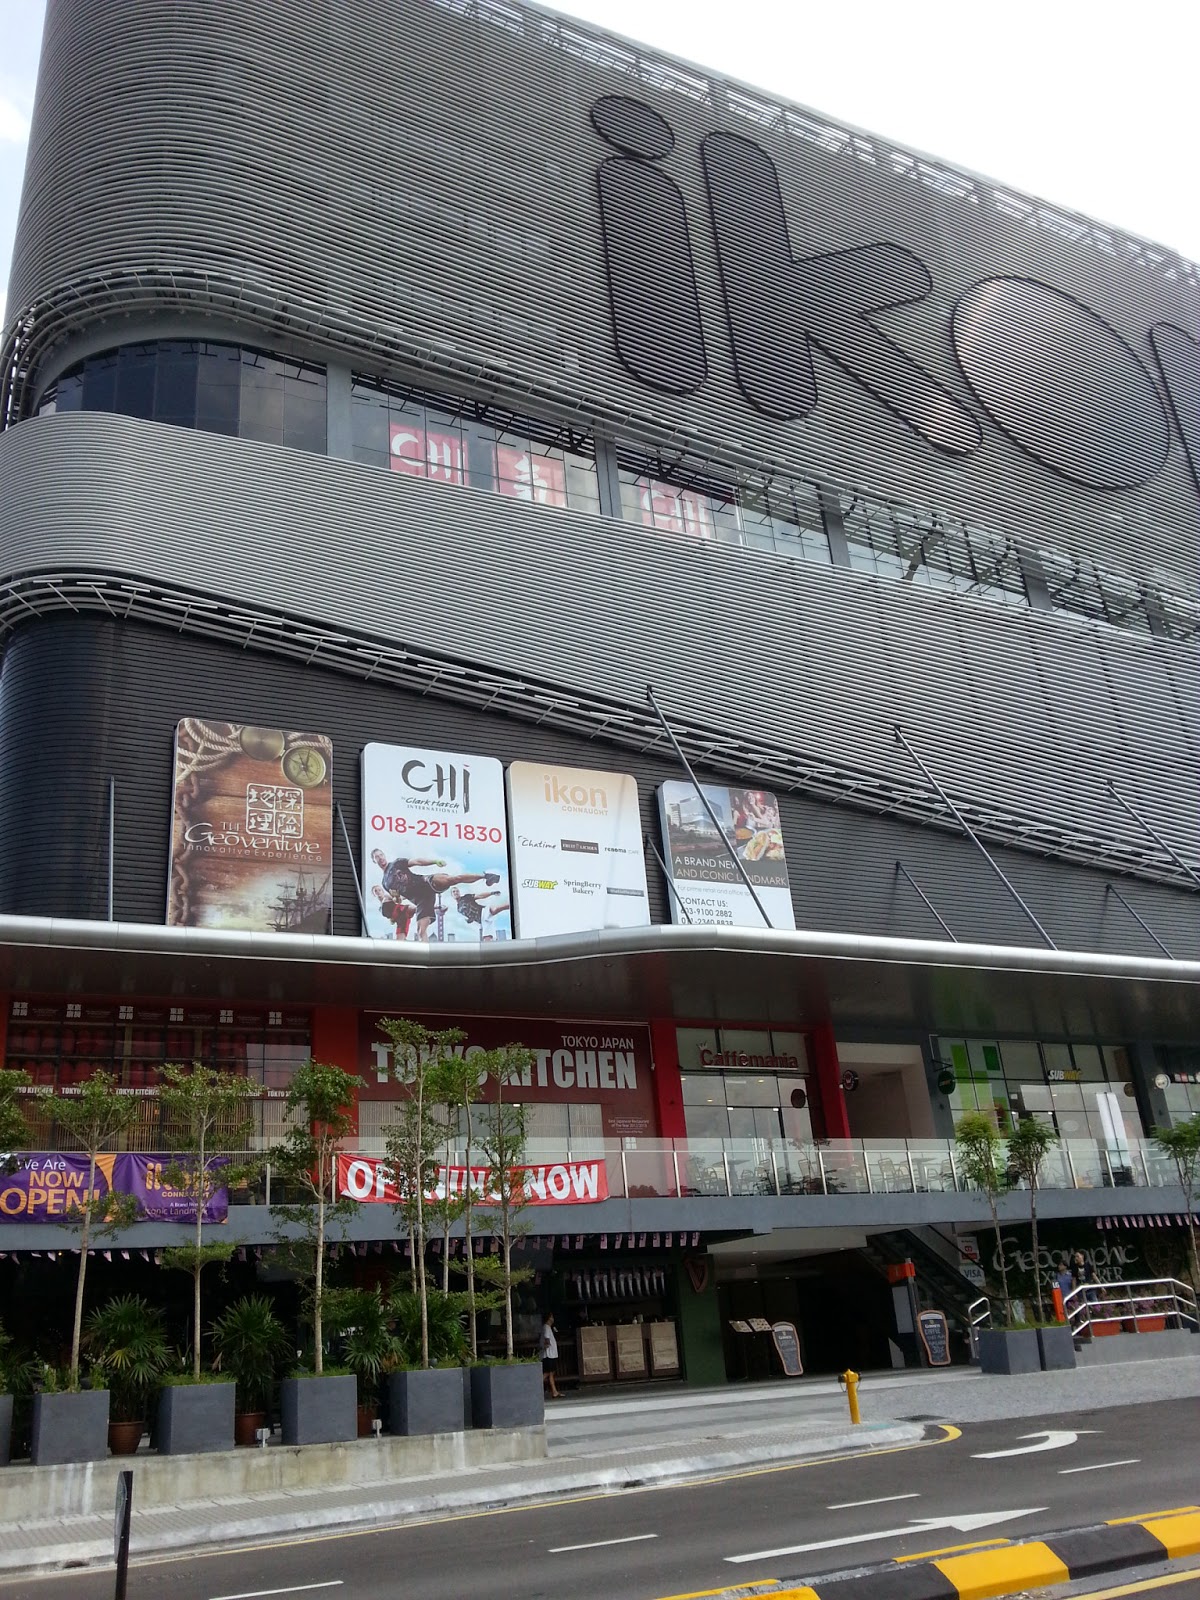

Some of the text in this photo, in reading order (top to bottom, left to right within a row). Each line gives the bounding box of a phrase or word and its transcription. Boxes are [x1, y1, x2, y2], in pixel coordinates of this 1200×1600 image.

[543, 774, 608, 808] ikon
[405, 797, 431, 806] Clark
[407, 804, 459, 814] INTERNATIONAL
[562, 805, 609, 816] CONNAUGHT
[371, 815, 503, 843] 018-221 1830
[521, 838, 557, 849] Chatime
[183, 843, 322, 862] Innovative Experience
[675, 856, 739, 869] A BRAND NEW
[676, 868, 698, 878] AND
[700, 870, 734, 881] ICONIC
[522, 879, 558, 890] SUBWAY
[563, 879, 602, 889] SpringBerry
[572, 887, 594, 896] Bakery
[680, 897, 715, 906] CONTACT
[561, 1035, 634, 1050] TOKYO JAPAN
[497, 1048, 637, 1090] KITCHEN
[1048, 1068, 1082, 1081] SUBWAY
[42, 1158, 67, 1171] Are
[29, 1170, 85, 1188] NOW
[347, 1160, 598, 1200] OPNING NOW
[170, 1207, 208, 1216] Landmk
[963, 1269, 982, 1278] VISA
